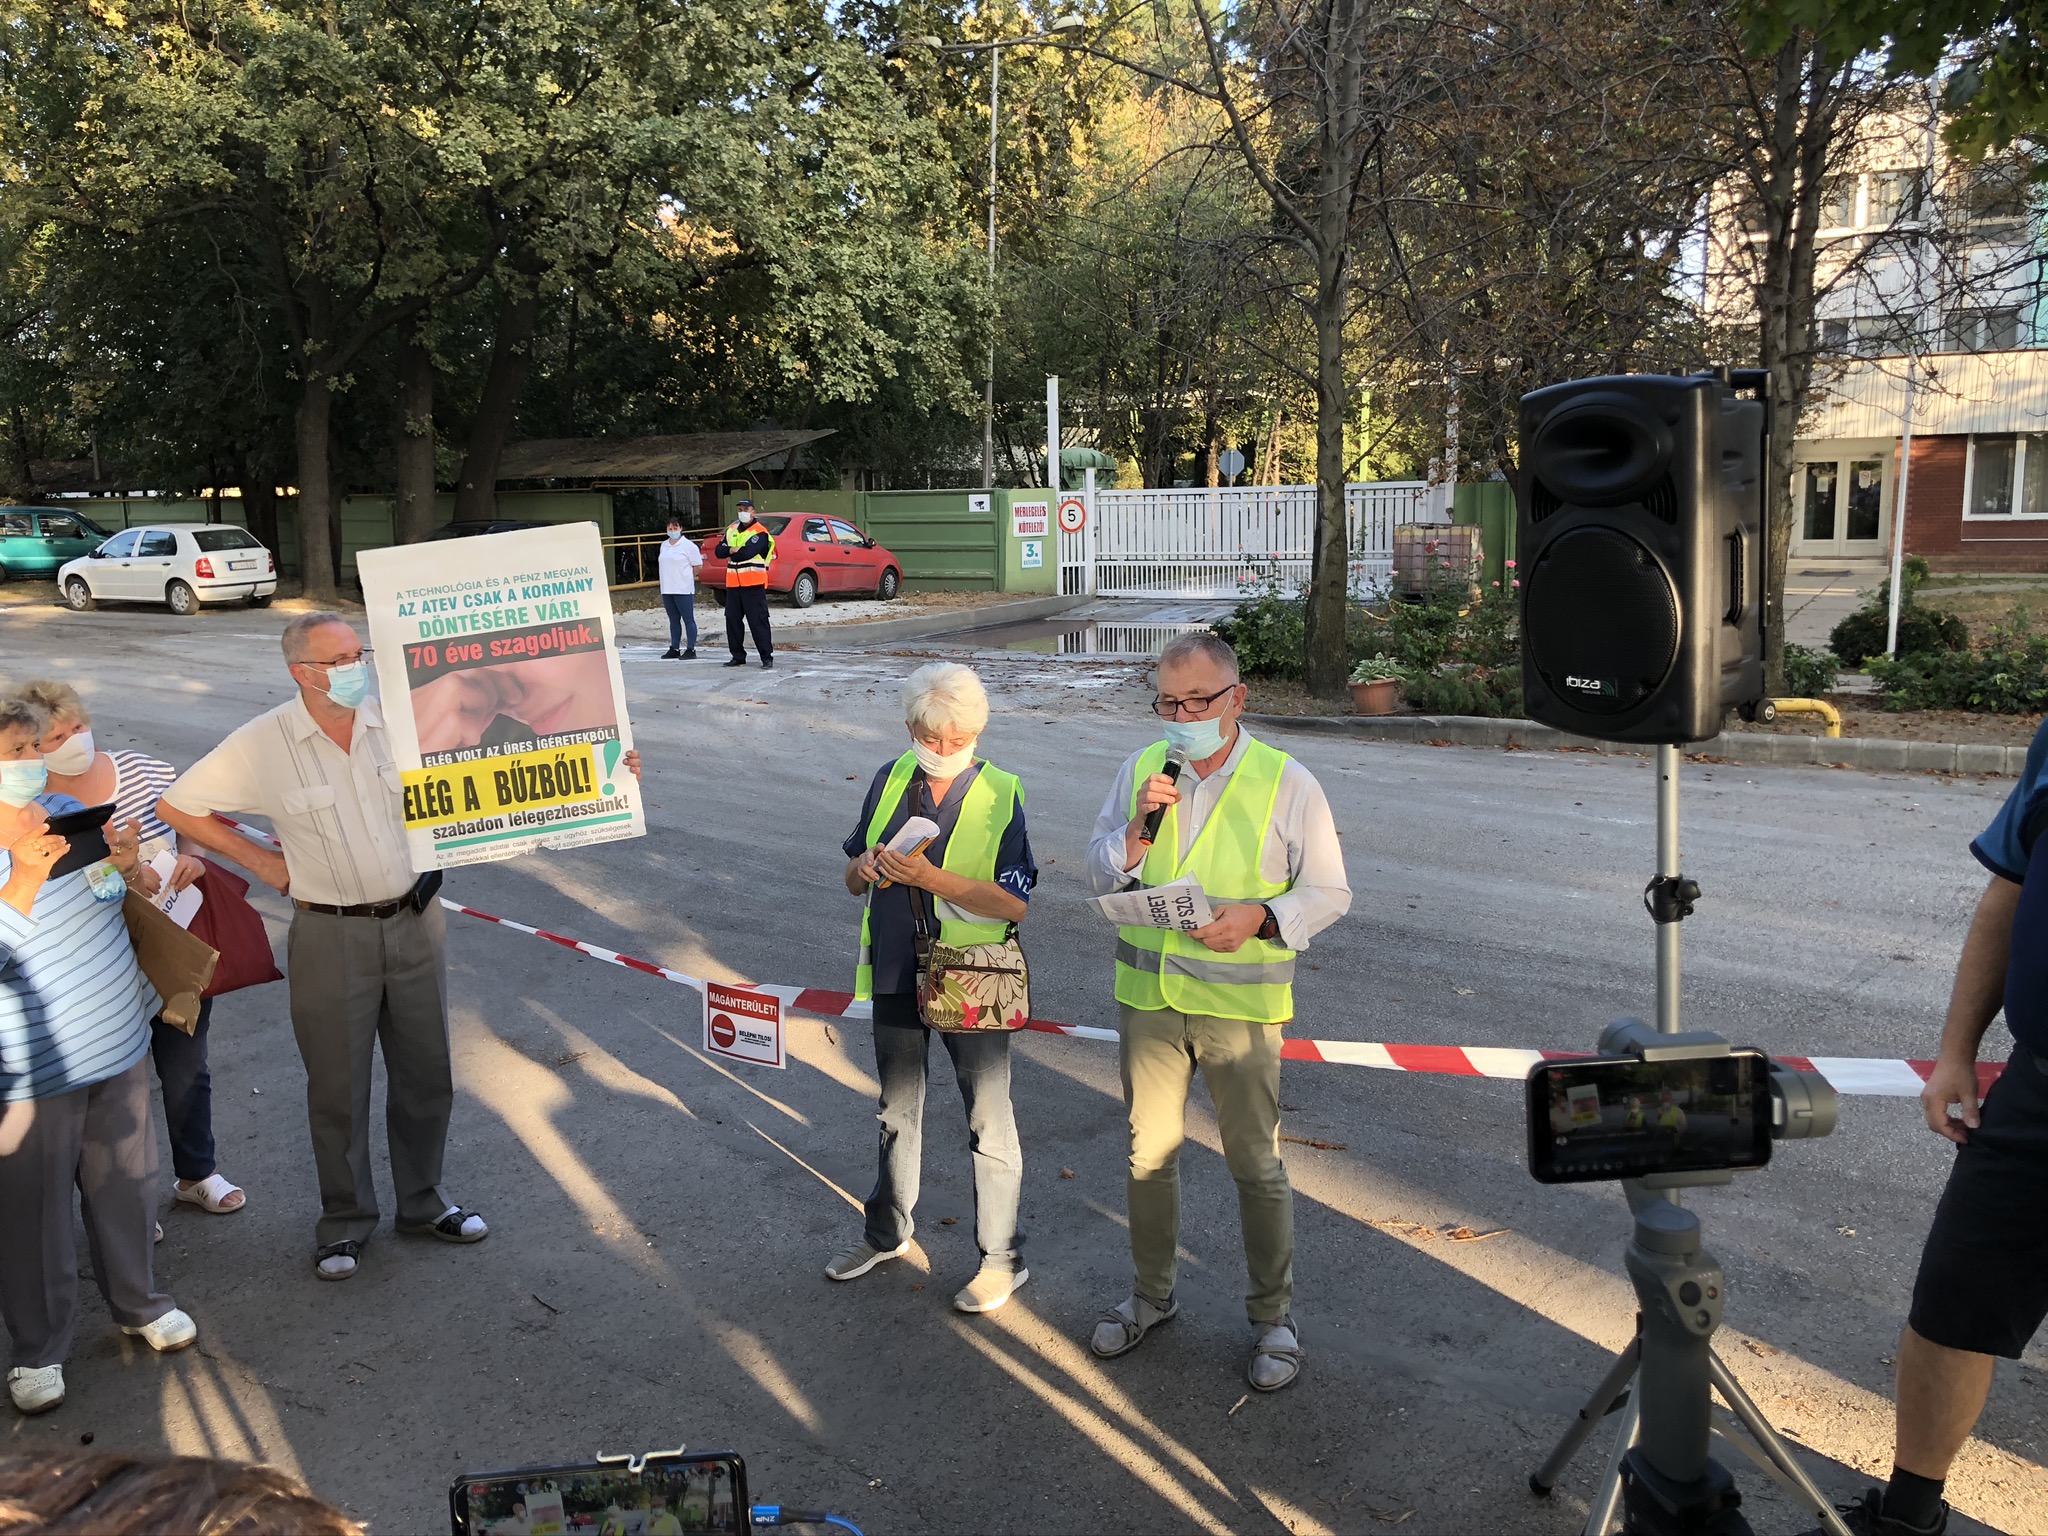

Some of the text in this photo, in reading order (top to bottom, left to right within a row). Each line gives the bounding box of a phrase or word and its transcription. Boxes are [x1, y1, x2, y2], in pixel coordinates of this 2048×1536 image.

[1014, 506, 1046, 518] MÉRLEGELÉS
[1068, 510, 1076, 522] 5
[1026, 544, 1038, 558] 3.
[396, 566, 592, 600] A TECHNOLÓGIA ÉS A PÉNZ MEGVAN.
[398, 578, 594, 617] AZ ATEV CSAK A KORMÁNY
[418, 598, 580, 638] DÖNTÉSÉRE VÁR!
[408, 624, 600, 669] 70 éve szagoljuk.
[1566, 676, 1600, 689] ibiza
[425, 752, 452, 768] ELÉG
[456, 748, 482, 762] VOLT
[486, 746, 500, 758] AZ
[504, 738, 533, 755] ÜRES
[404, 753, 592, 822] ELÉG A BŰZBŐL!
[432, 795, 630, 840] szabadon lélegezhessünk!
[1146, 895, 1170, 926] ÍGÉRET
[709, 992, 776, 1016] MAGÁNTERÜLET!
